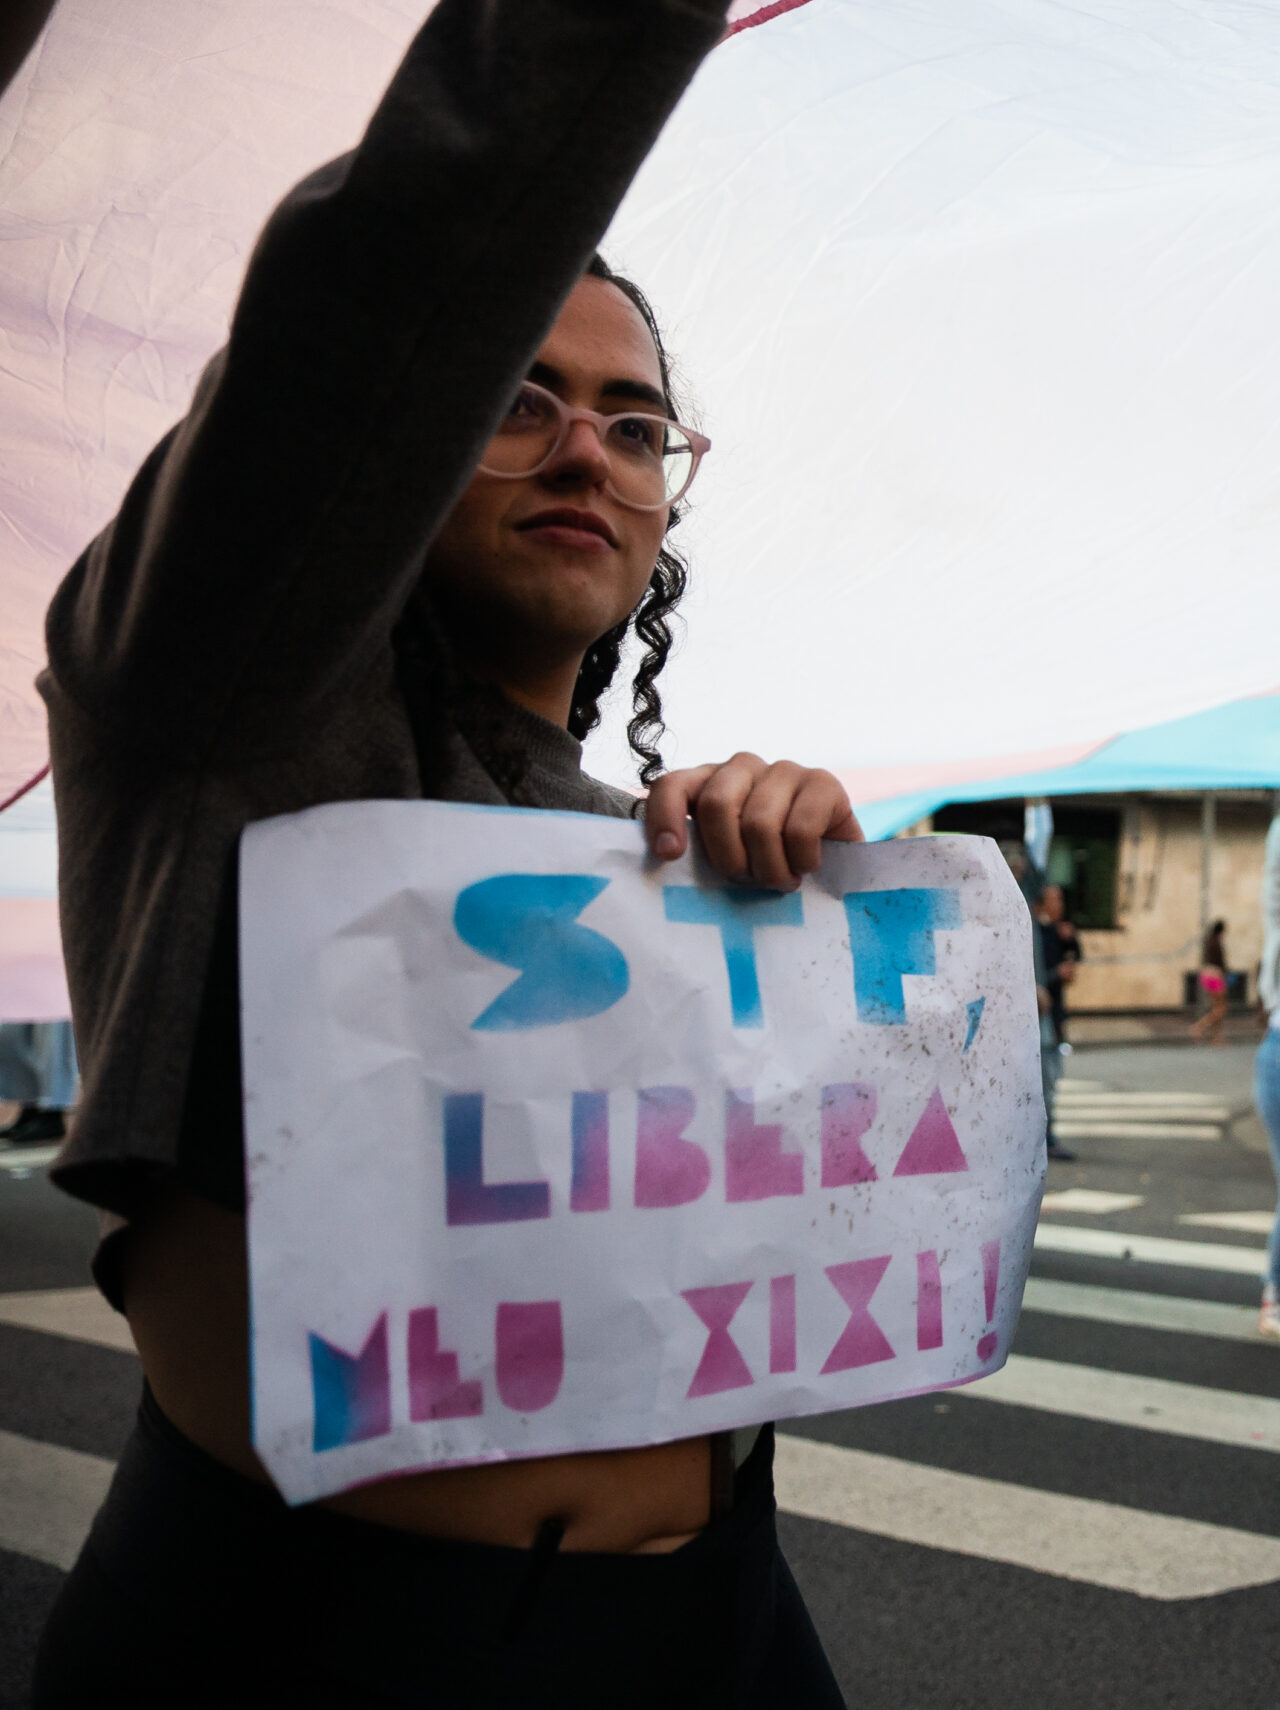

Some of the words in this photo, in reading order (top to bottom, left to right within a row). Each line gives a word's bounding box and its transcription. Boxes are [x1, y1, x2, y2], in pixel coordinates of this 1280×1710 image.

[454, 872, 986, 1053] STF,
[443, 1084, 969, 1227] LIBERA
[308, 1299, 565, 1453] MEU
[679, 1241, 999, 1399] XIXI!
